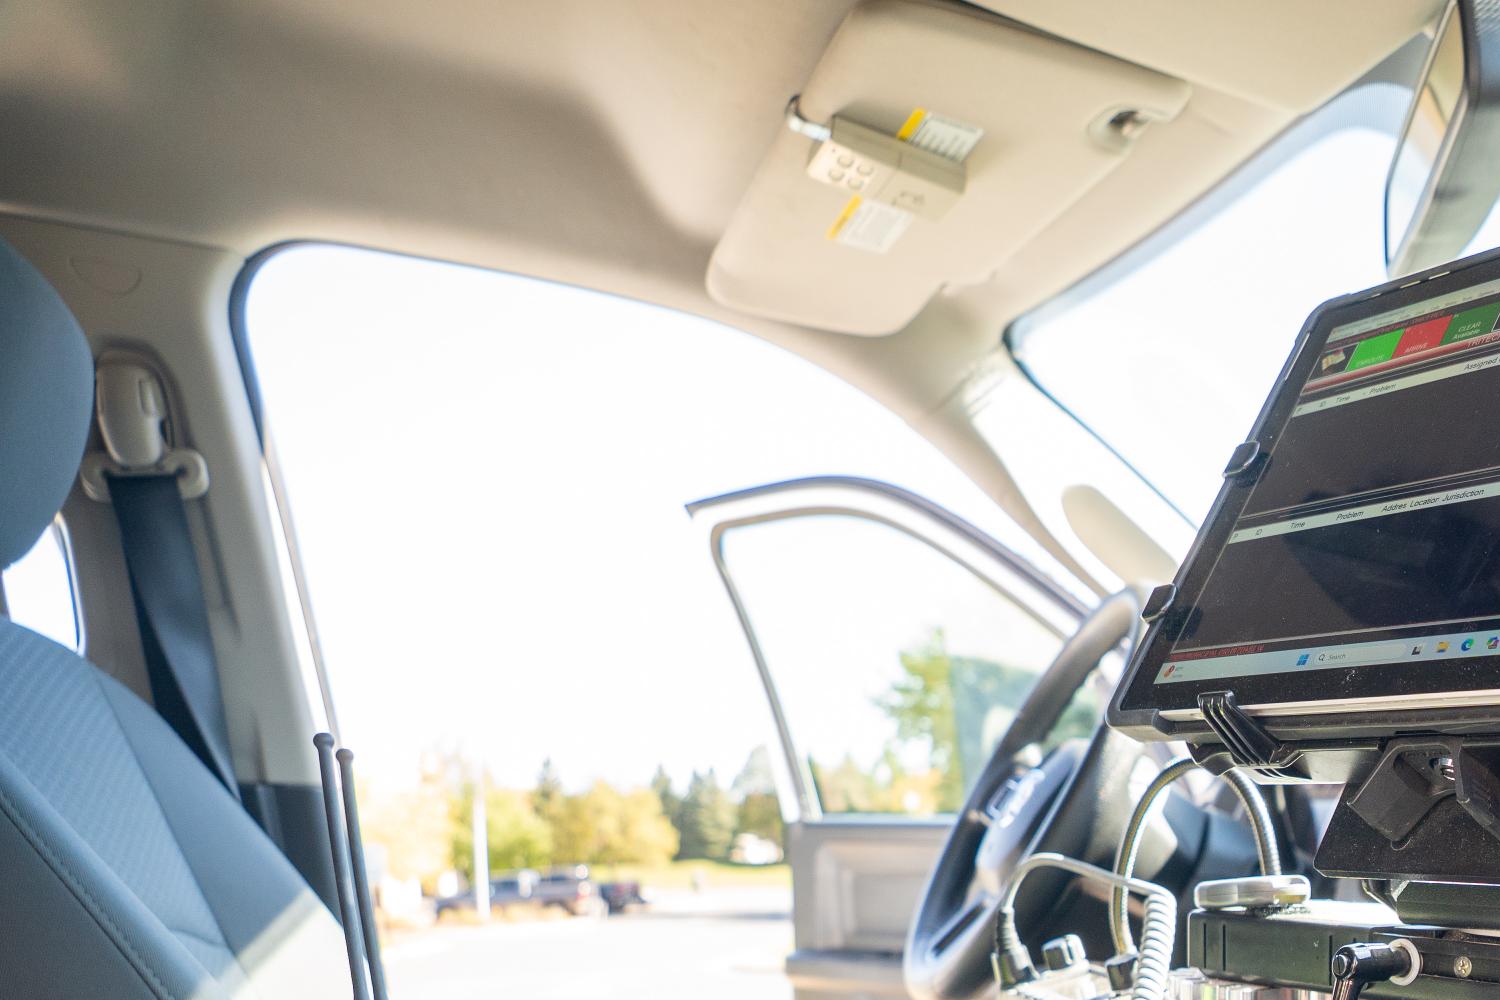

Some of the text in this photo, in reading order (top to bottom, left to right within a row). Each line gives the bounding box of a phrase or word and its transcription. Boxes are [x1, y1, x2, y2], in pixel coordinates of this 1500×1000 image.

[1458, 321, 1482, 332] CLEAR
[1369, 383, 1397, 395] Problem
[1464, 356, 1499, 371] Assigned
[1290, 521, 1306, 529] Time
[1336, 511, 1365, 521] Problem
[1442, 488, 1486, 504] Jurisdiction
